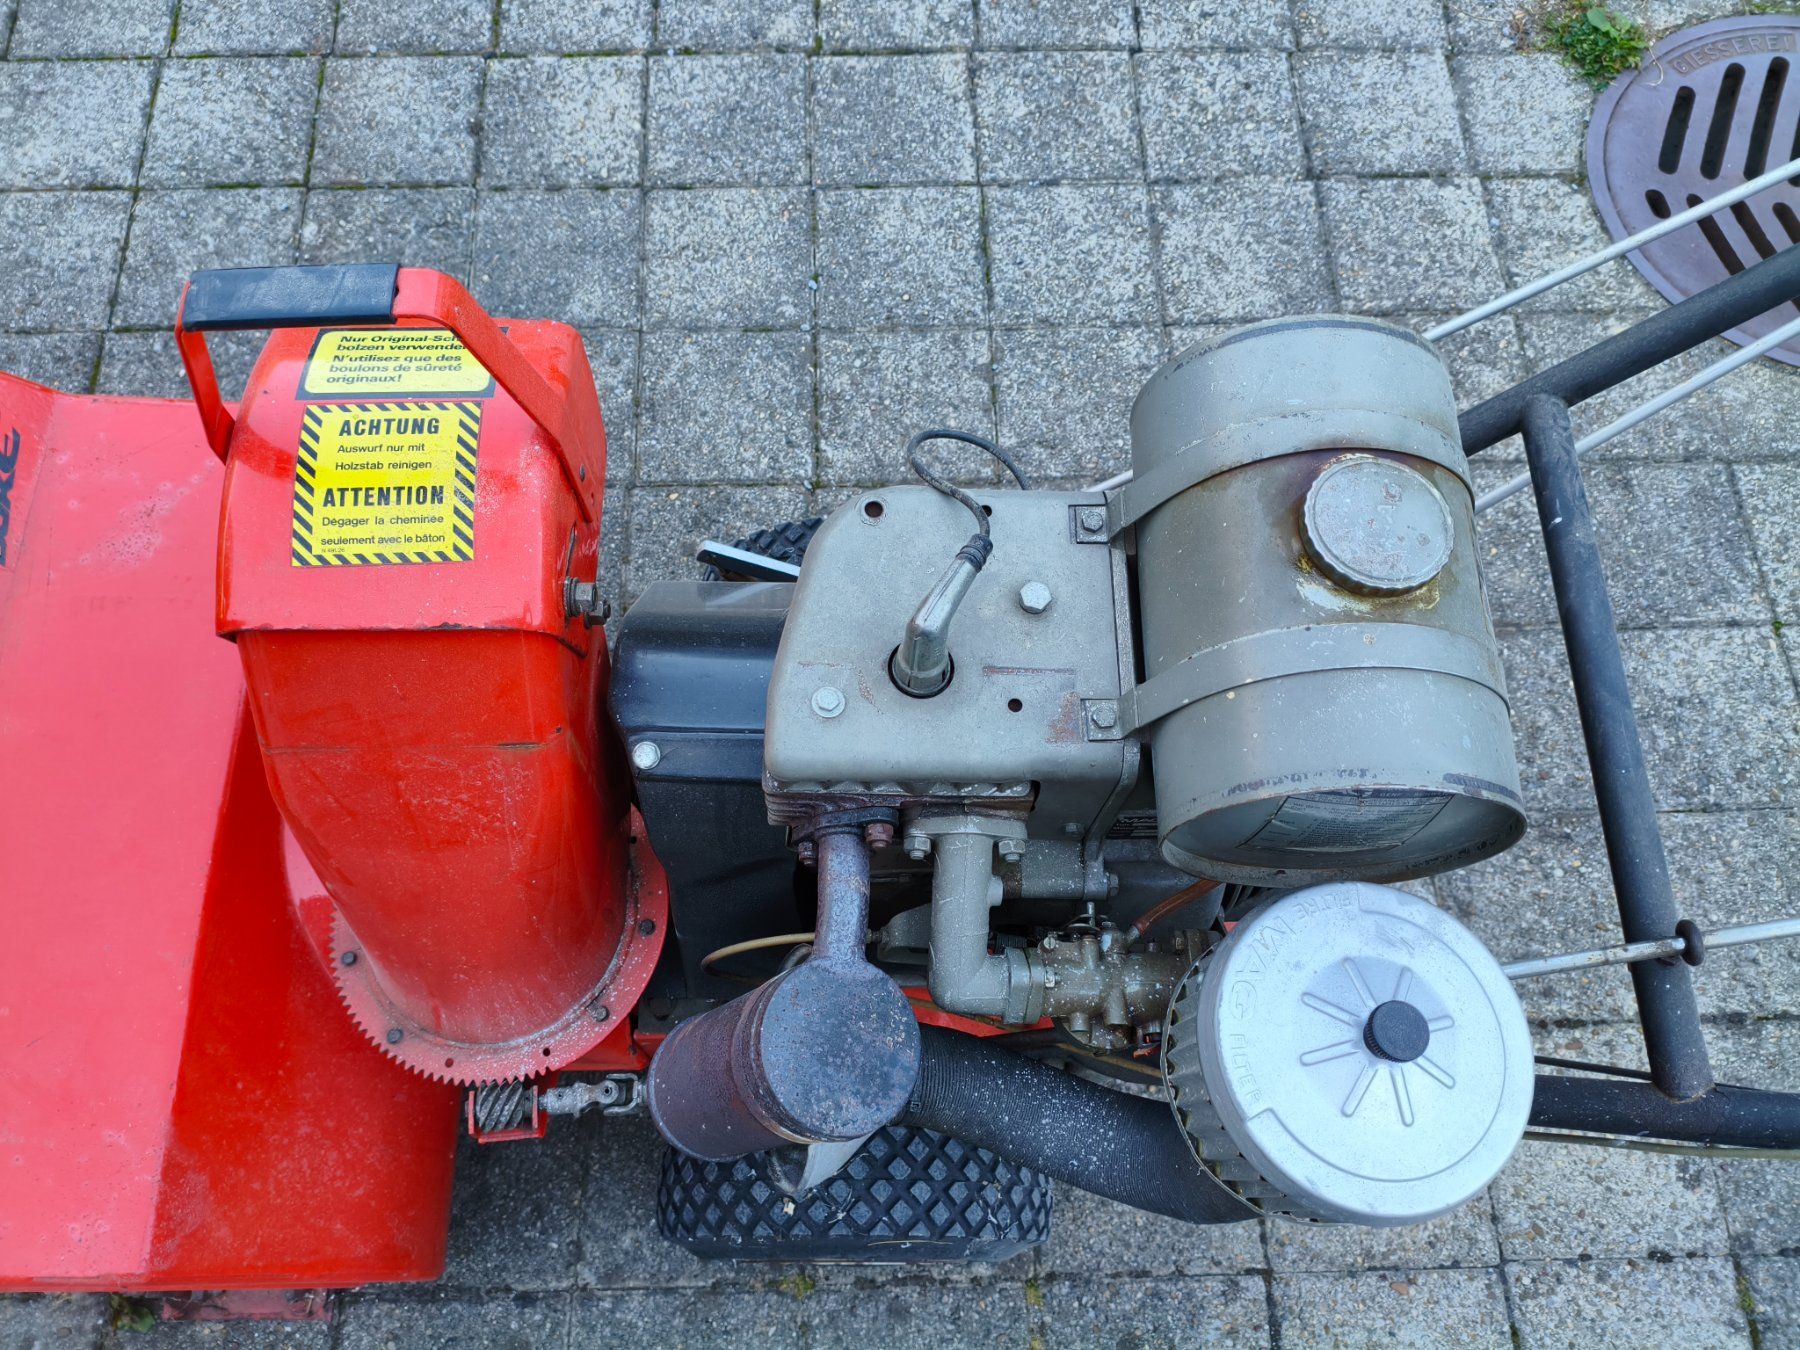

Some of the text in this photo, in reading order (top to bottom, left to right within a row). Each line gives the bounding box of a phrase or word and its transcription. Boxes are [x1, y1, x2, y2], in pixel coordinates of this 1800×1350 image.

[1672, 36, 1789, 74] GIESSEREI
[329, 364, 390, 372] boulons
[415, 363, 462, 372] sûreté
[326, 374, 402, 384] originaux!
[339, 418, 440, 436] ACHTUNG
[337, 445, 383, 453] Auswurf
[407, 444, 425, 452] mit
[335, 461, 432, 471] Holzstab reinigen
[323, 486, 444, 507] ATTENTION
[374, 516, 384, 525] la
[389, 515, 444, 525] cheminée
[321, 536, 375, 545] seulement
[404, 534, 413, 543] le
[415, 533, 445, 543] bâton
[1230, 1033, 1262, 1104] FILTER
